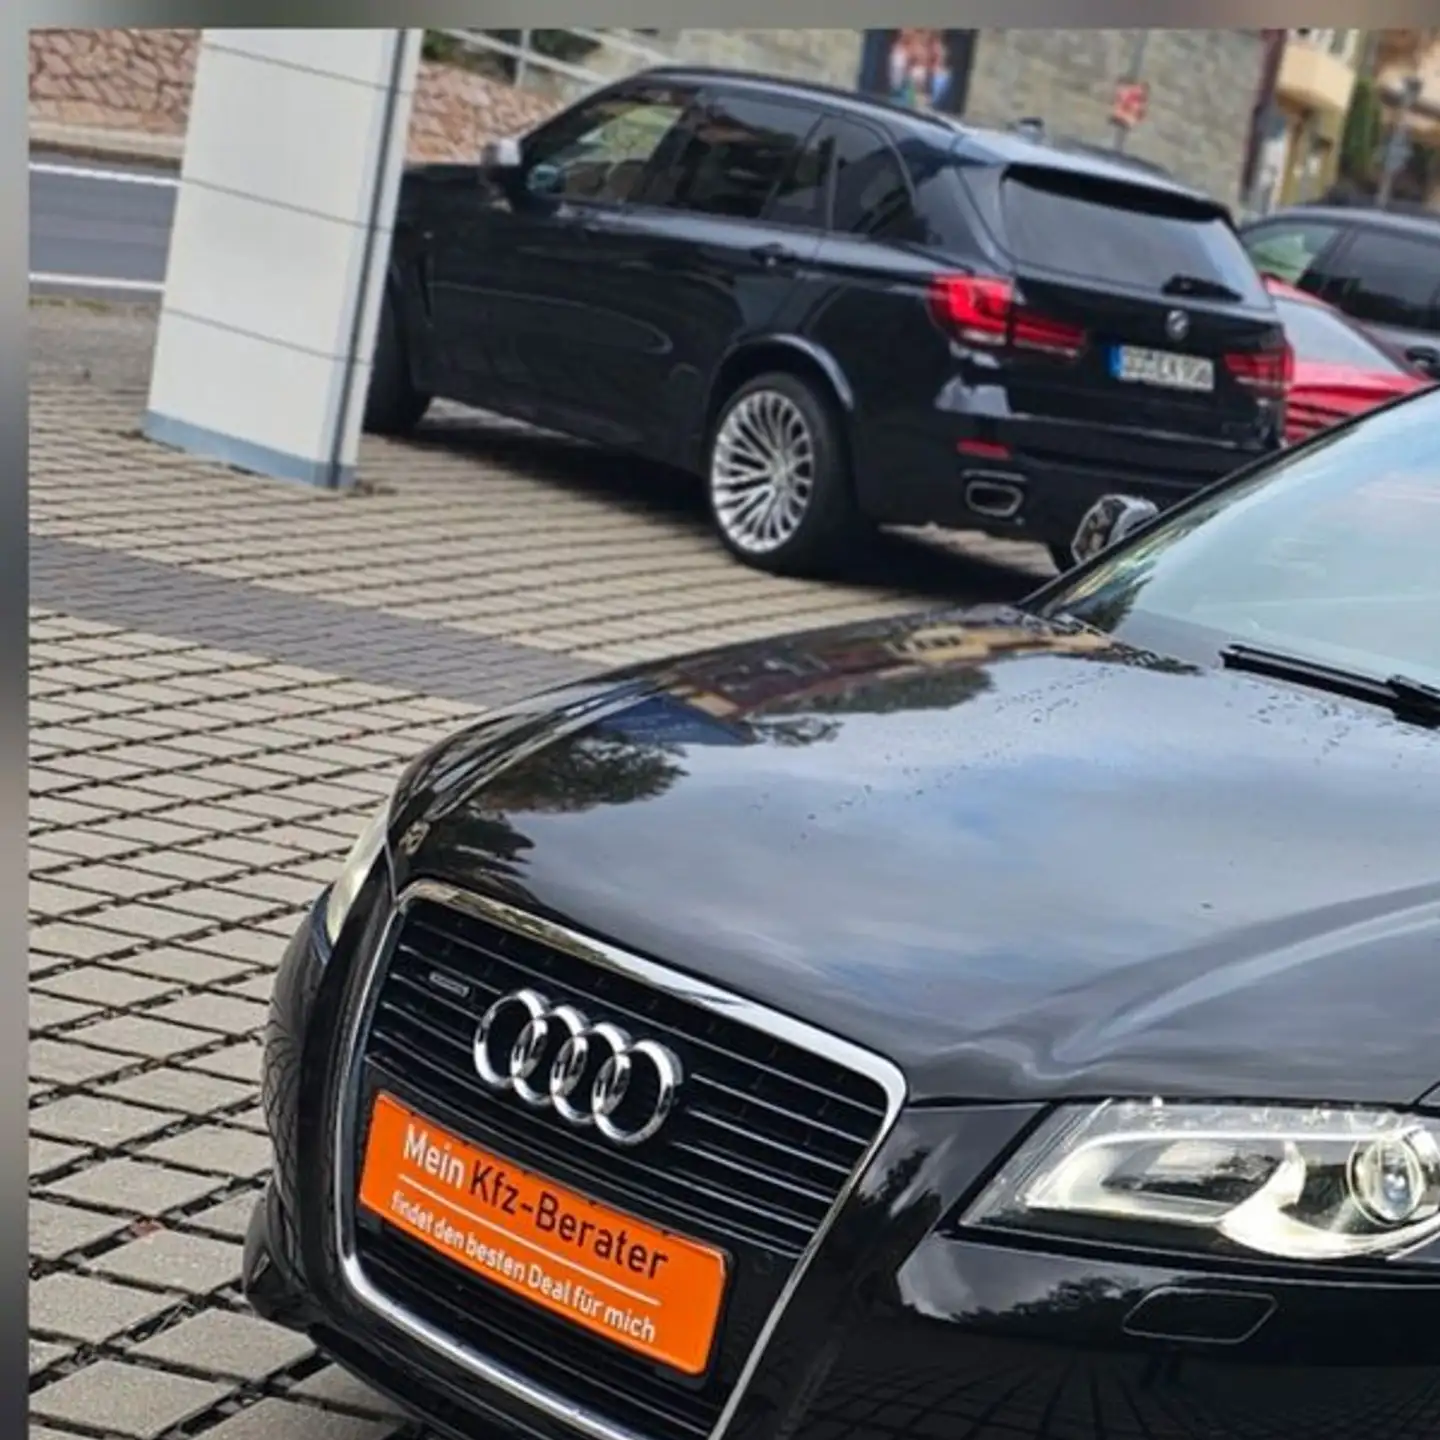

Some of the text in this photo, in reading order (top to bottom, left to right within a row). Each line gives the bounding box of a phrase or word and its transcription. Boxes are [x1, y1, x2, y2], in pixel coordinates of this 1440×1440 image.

[391, 1190, 434, 1233] findet
[434, 1218, 464, 1249] den
[466, 1232, 525, 1283] besten
[528, 1263, 571, 1306] Deal
[604, 1305, 656, 1343] mich
[403, 1123, 669, 1280] Mein Kfz-Berater
